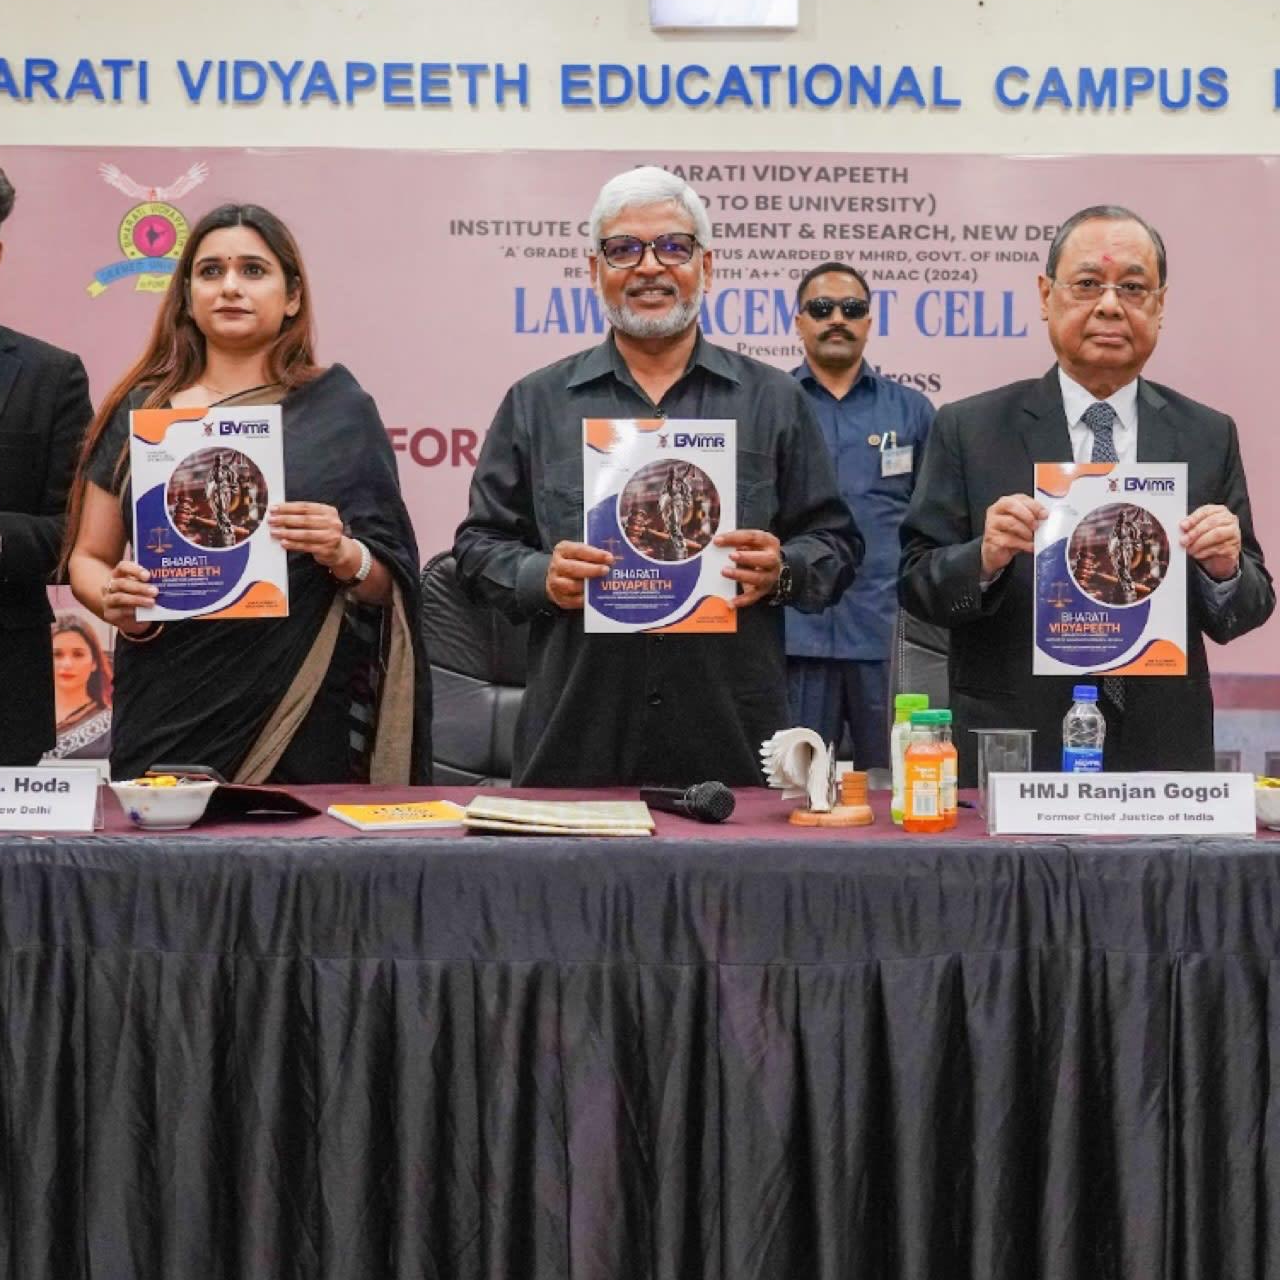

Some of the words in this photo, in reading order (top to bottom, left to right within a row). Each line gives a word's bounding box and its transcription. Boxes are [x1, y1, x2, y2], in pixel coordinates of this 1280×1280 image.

[176, 59, 529, 108] VIDYAPEETH
[560, 62, 963, 109] EDUCATIONAL
[994, 65, 1230, 110] CAMPUS
[753, 165, 909, 184] VIDYAPEETH
[717, 194, 749, 211] TO
[754, 195, 784, 212] BE
[788, 192, 937, 216] UNIVERSITY)
[449, 219, 571, 238] INSTITUTE
[798, 223, 819, 240] &
[823, 224, 956, 243] RESEARCH,
[962, 225, 1020, 241] NEW
[523, 246, 578, 259] GRADE
[747, 249, 831, 261] AWARDED
[833, 249, 855, 262] BY
[859, 250, 912, 263] MHRD,
[915, 250, 967, 263] GOVT.
[970, 250, 992, 263] OF
[995, 251, 1040, 264] INDIA
[872, 269, 920, 282] NAAC
[923, 267, 979, 284] (2024)
[914, 289, 1028, 338] CELL
[736, 341, 805, 358] Presents
[161, 555, 208, 567] BHARATI
[149, 566, 221, 577] VIDYAPEETH
[613, 568, 660, 579] BHARATI
[601, 579, 673, 591] VIDYAPEETH
[1061, 612, 1109, 622] BHARATI
[1048, 623, 1121, 633] VIDYAPEETH
[14, 777, 71, 793] Hoda
[1019, 782, 1069, 800] HMJ
[1077, 782, 1157, 802] Ranjan
[1163, 782, 1230, 802] Gogoi
[19, 805, 52, 815] Delhi
[1037, 813, 1079, 822] Former
[1083, 812, 1116, 822] Chief
[1119, 812, 1165, 822] Justice
[1168, 812, 1180, 822] of
[1183, 812, 1214, 822] India
